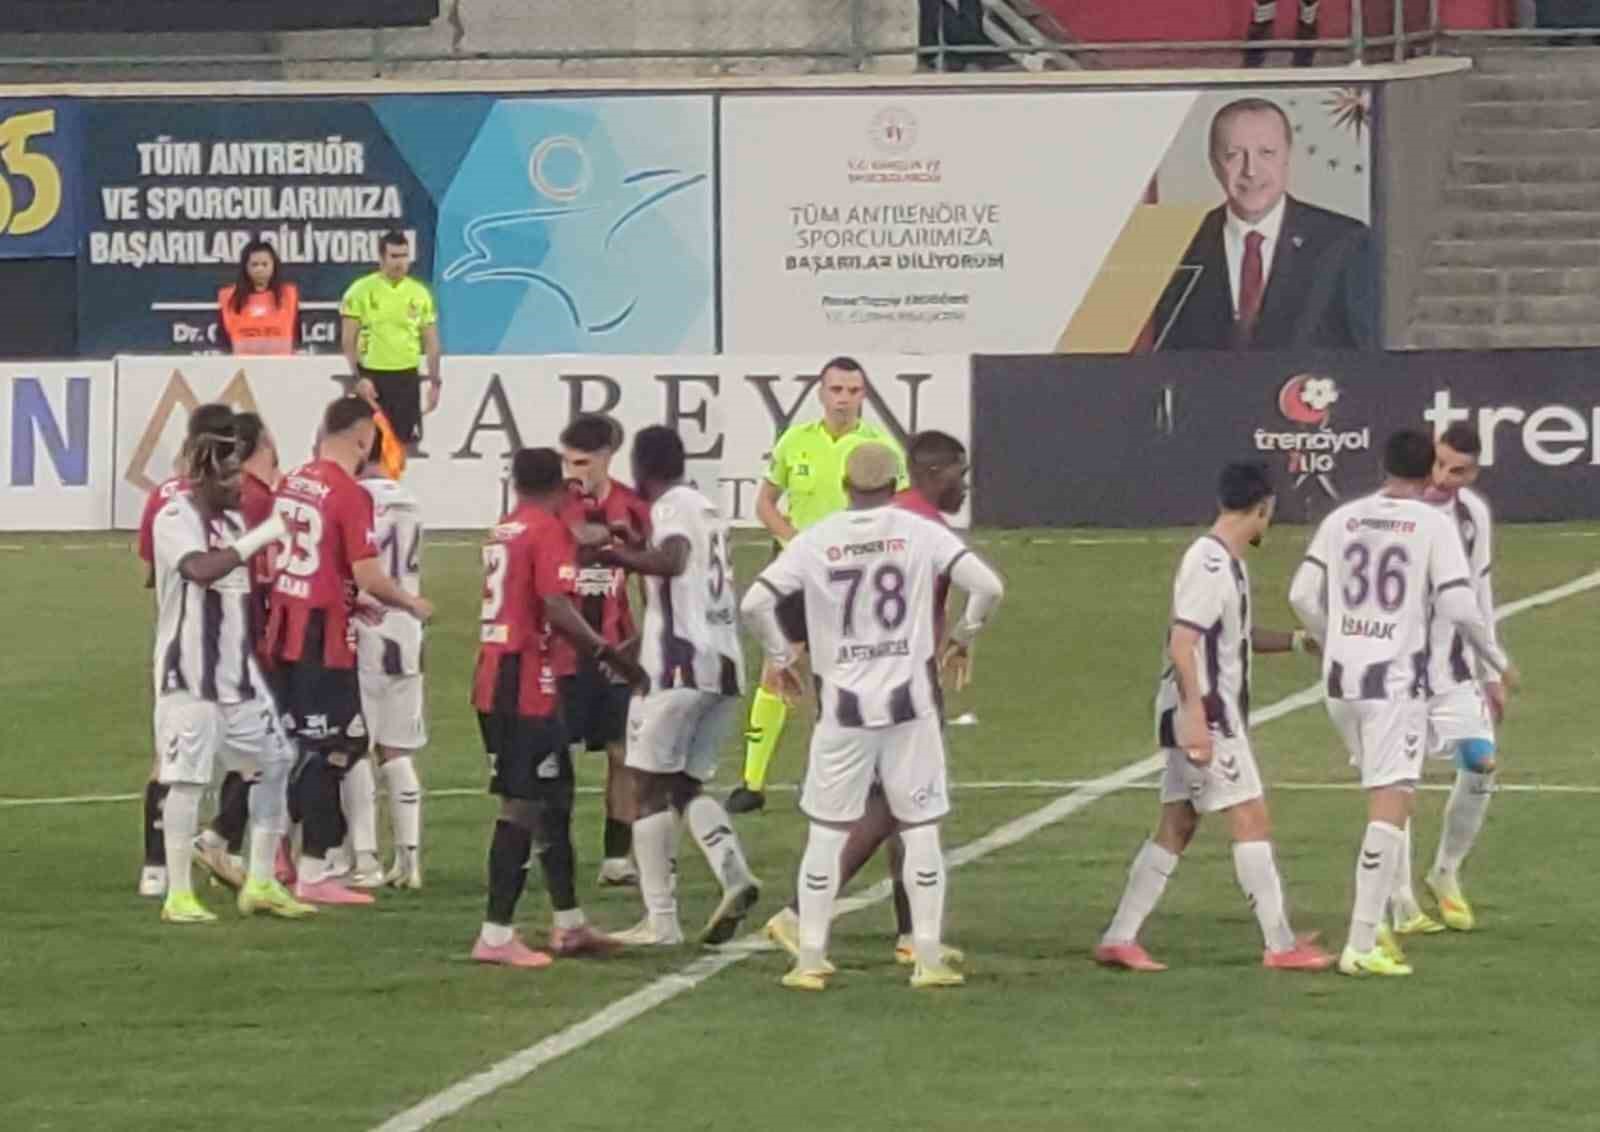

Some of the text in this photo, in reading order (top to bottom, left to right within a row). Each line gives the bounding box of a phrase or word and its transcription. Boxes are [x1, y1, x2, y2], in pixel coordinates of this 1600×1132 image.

[137, 135, 364, 176] TÜM ANTRENÖR
[102, 187, 401, 220] VE SPORCULARIMIZA
[789, 202, 839, 226] TÜM
[971, 205, 999, 224] VE
[173, 322, 204, 343] Dr.
[301, 322, 337, 343] LCI
[1424, 391, 1600, 466] tre
[1343, 542, 1408, 612] 36
[829, 565, 907, 636] 78
